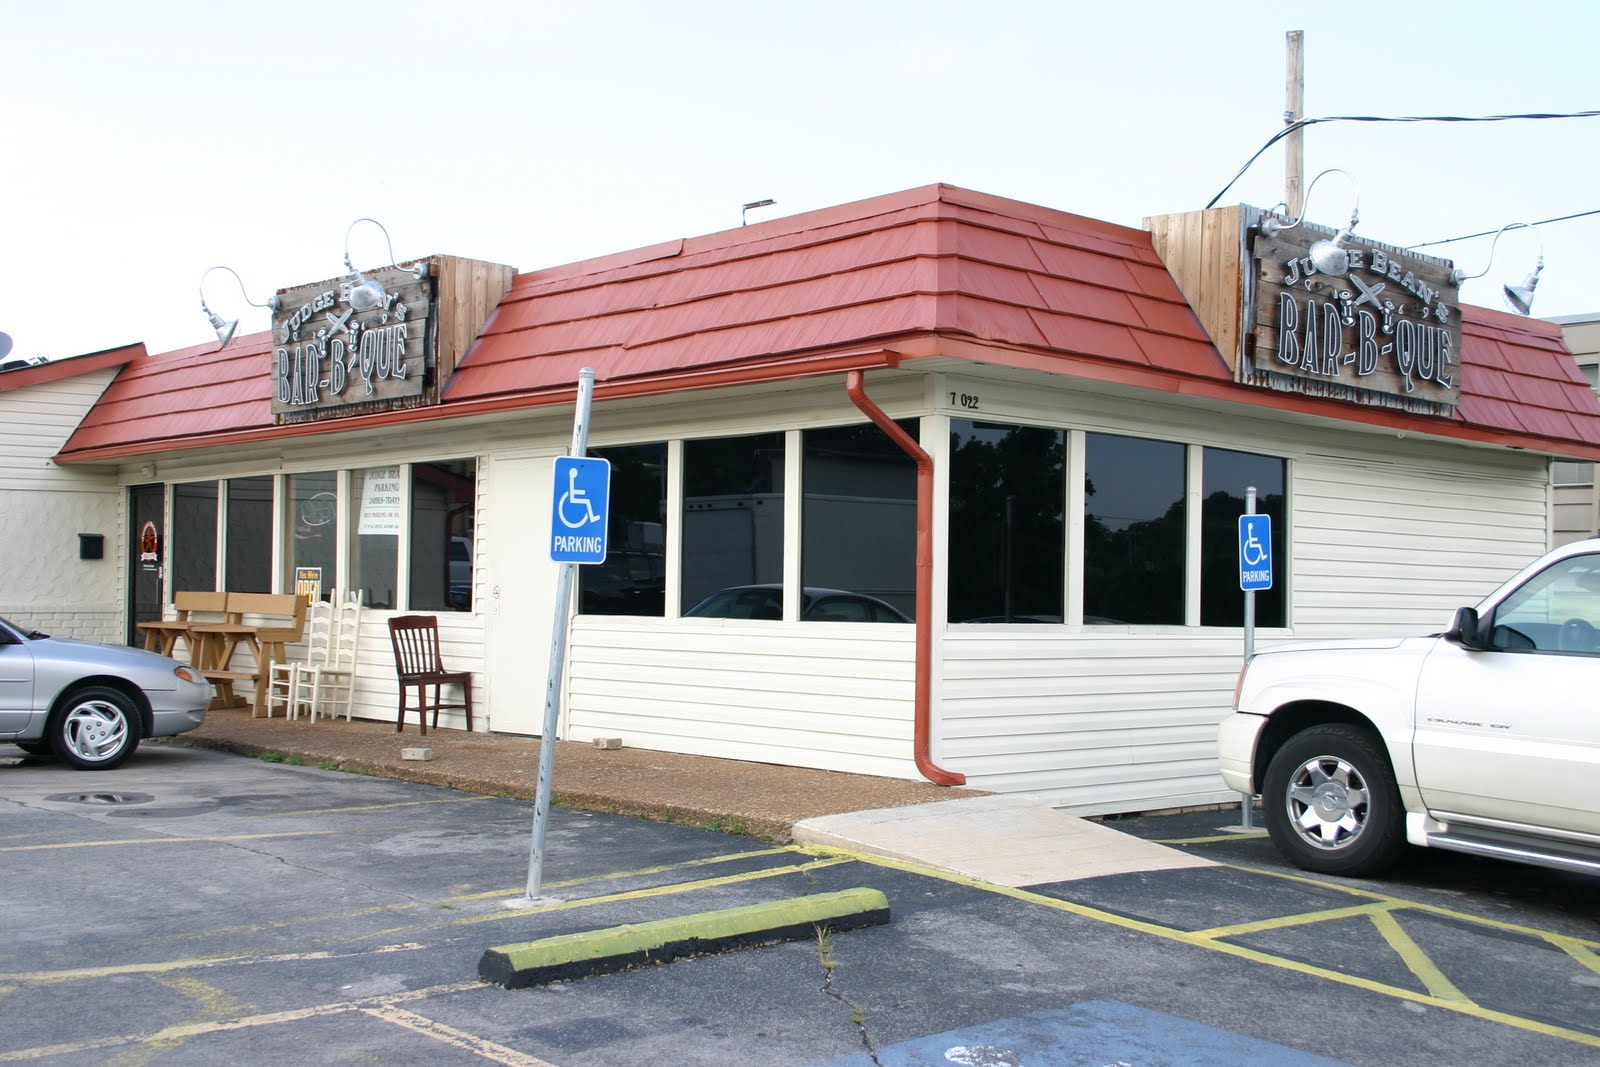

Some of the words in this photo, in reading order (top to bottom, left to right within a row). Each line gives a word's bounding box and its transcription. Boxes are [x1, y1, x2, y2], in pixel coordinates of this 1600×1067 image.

[280, 290, 335, 344] JUDGE
[338, 282, 408, 322] BN'S
[1284, 250, 1364, 287] JUE
[1370, 249, 1449, 324] BEAN'S
[277, 322, 408, 405] BAR-B-QUE
[1278, 291, 1453, 393] BAR-B-QUE
[375, 483, 400, 492] PARKING
[554, 535, 602, 554] PARKING
[1242, 569, 1270, 583] PARKING
